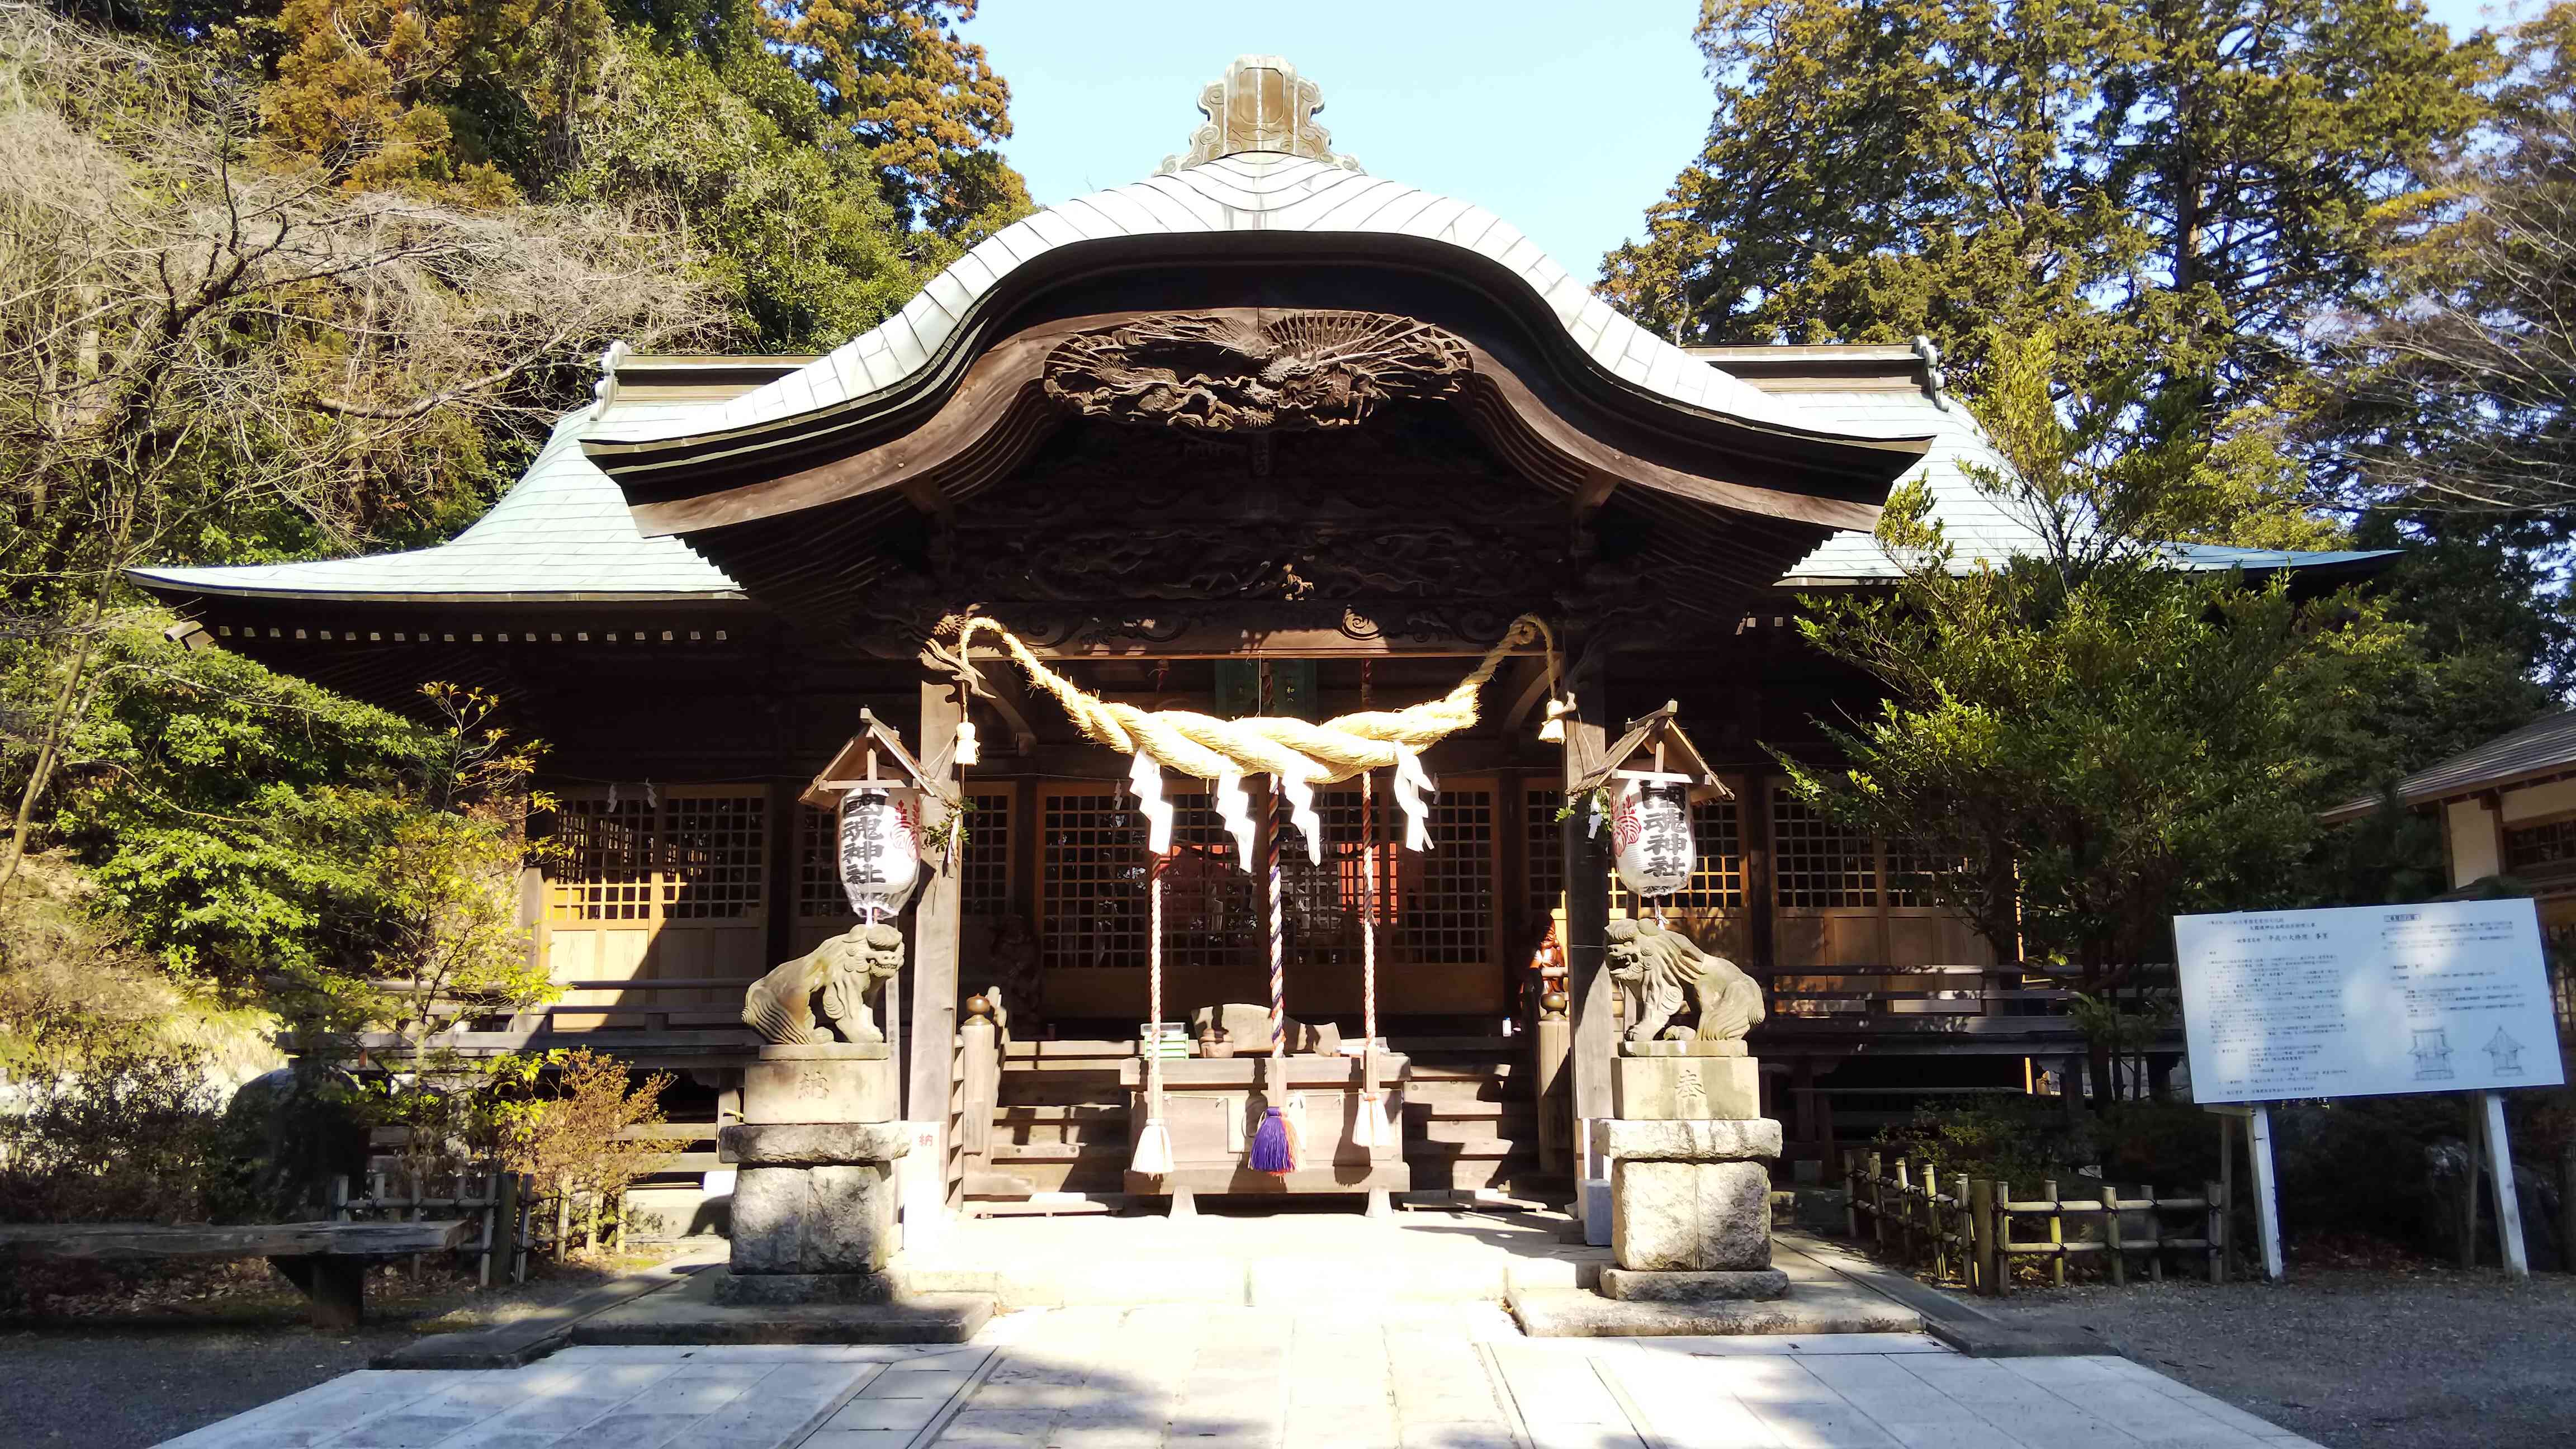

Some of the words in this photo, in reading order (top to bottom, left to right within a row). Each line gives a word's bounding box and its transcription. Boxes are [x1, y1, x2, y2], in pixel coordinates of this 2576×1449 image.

[841, 788, 887, 885] 國魂神社
[1641, 780, 1687, 878] 國魂神社
[1674, 1069, 1707, 1100] 奉
